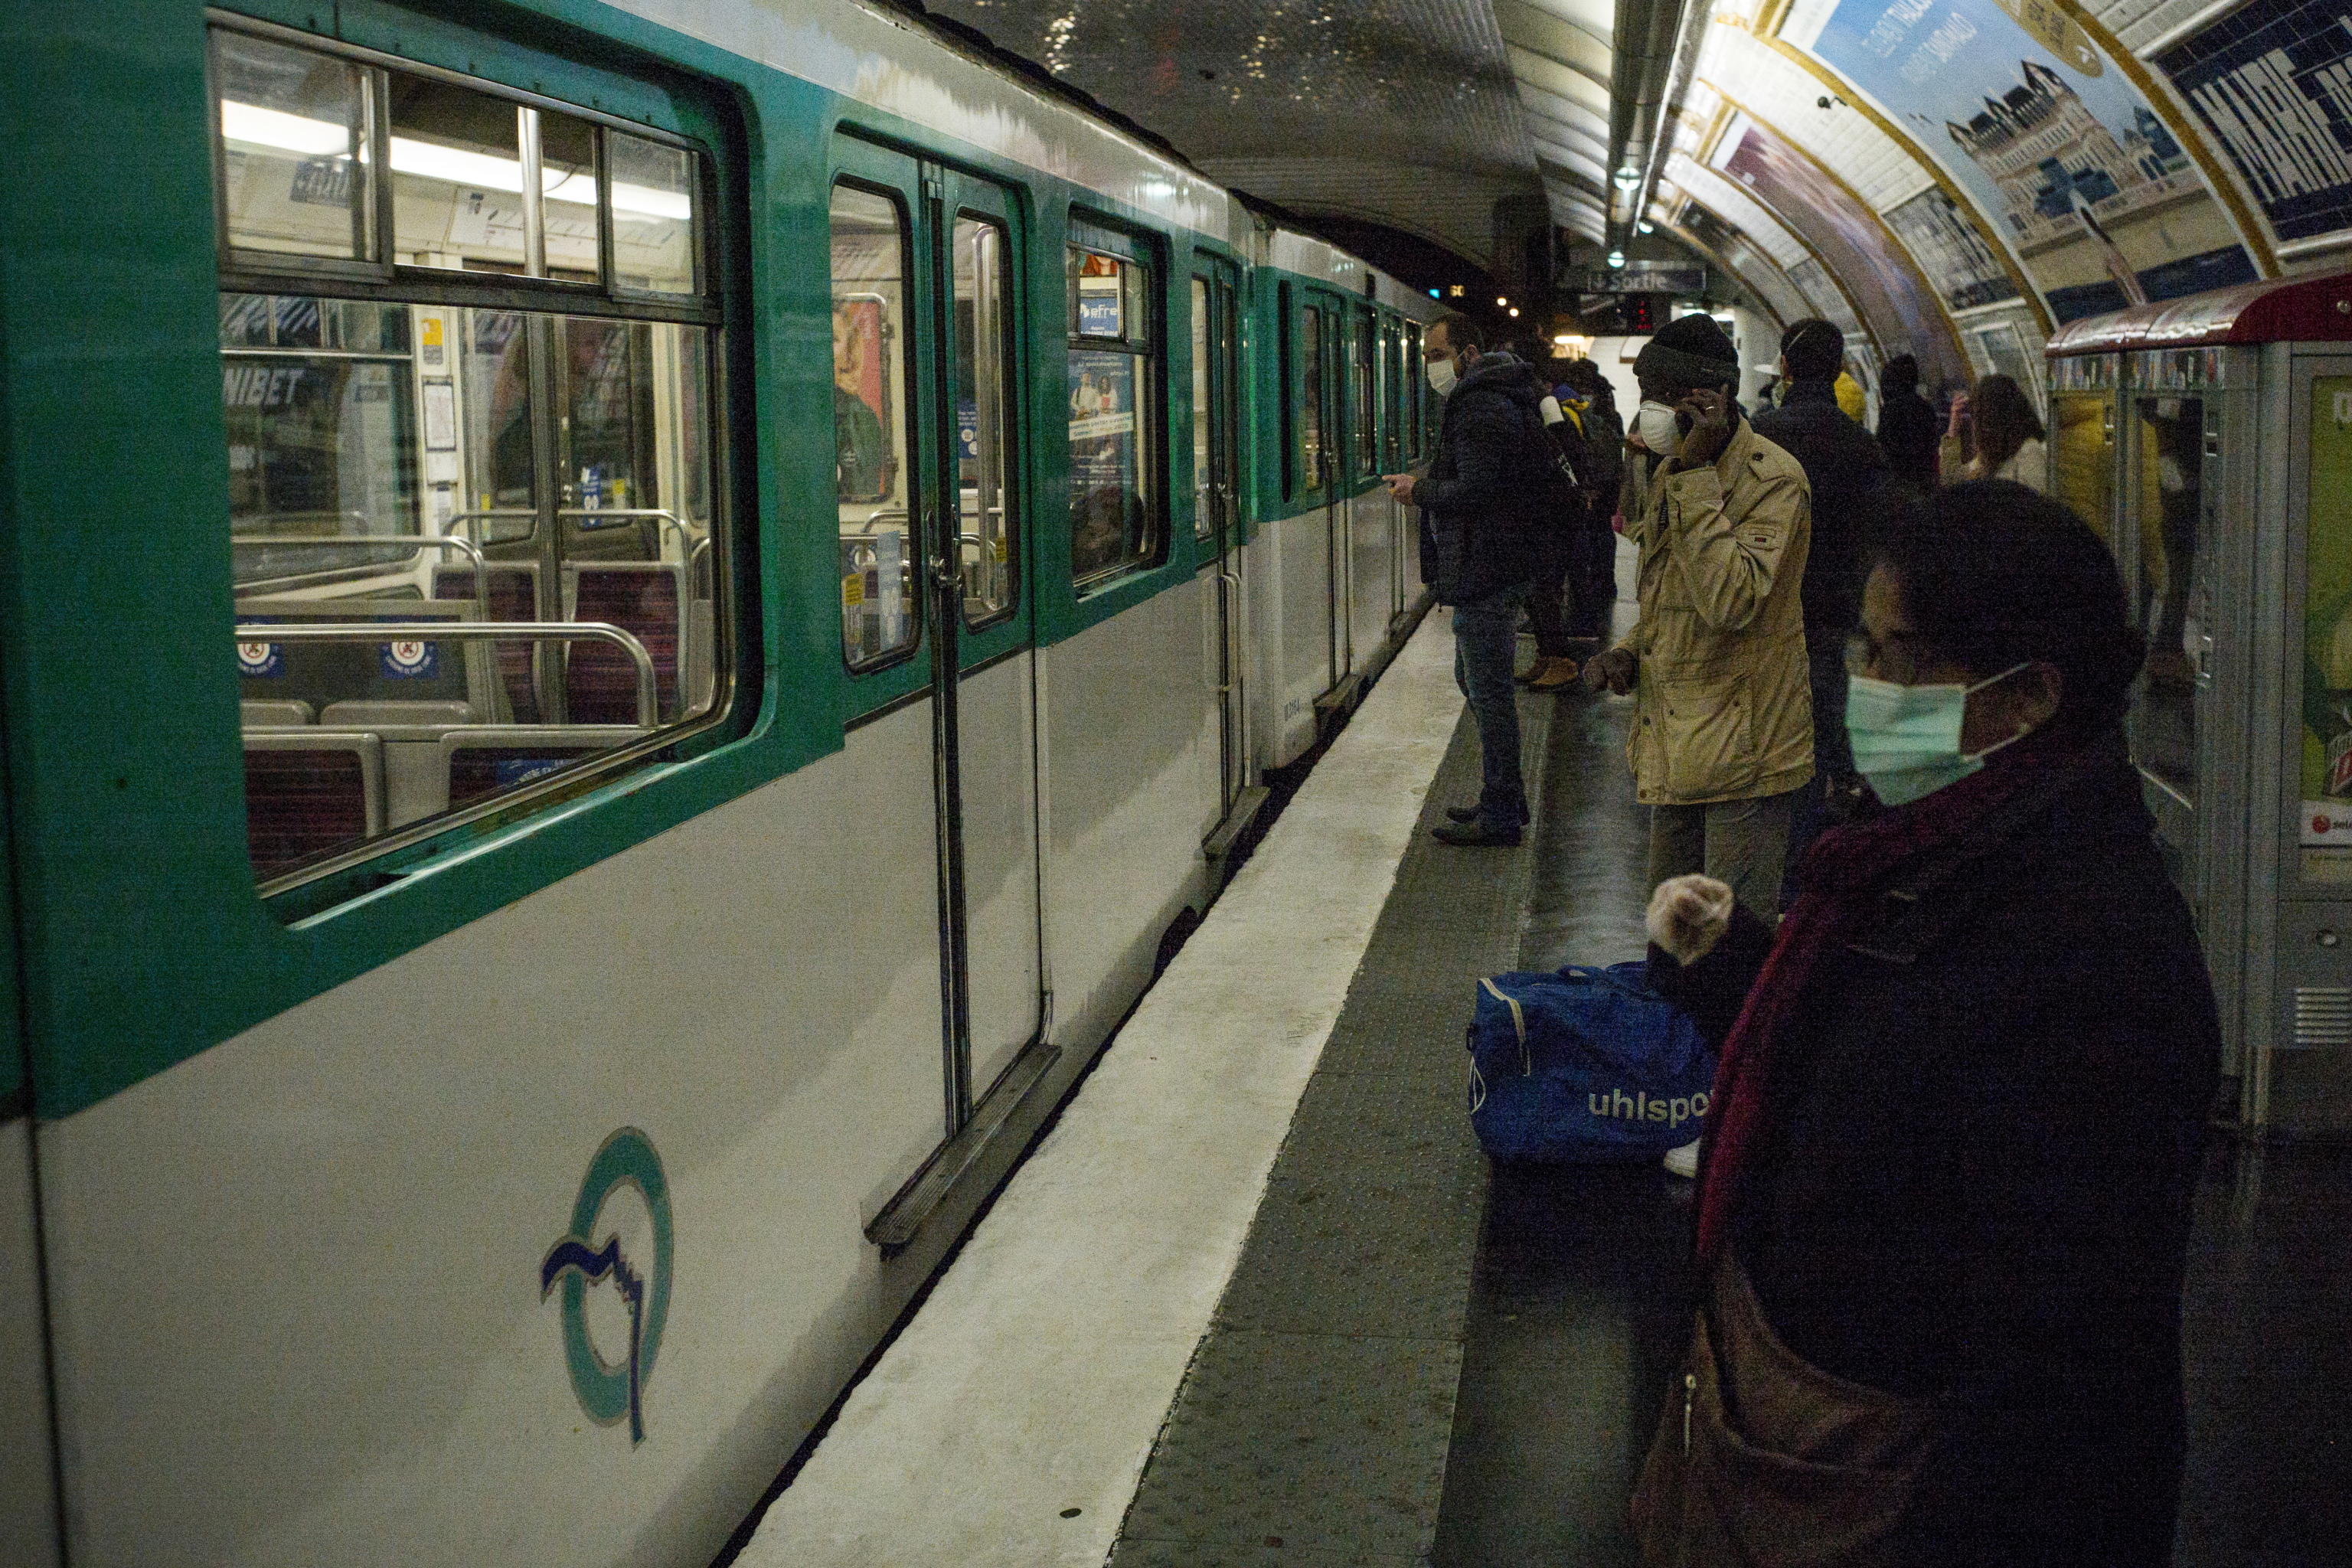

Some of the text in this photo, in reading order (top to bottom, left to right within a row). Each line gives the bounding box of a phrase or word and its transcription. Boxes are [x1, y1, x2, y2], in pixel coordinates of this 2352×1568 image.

[2190, 47, 2352, 204] MAIRIE
[1609, 272, 1668, 291] Sortie
[1589, 1088, 1715, 1128] uhlspo
